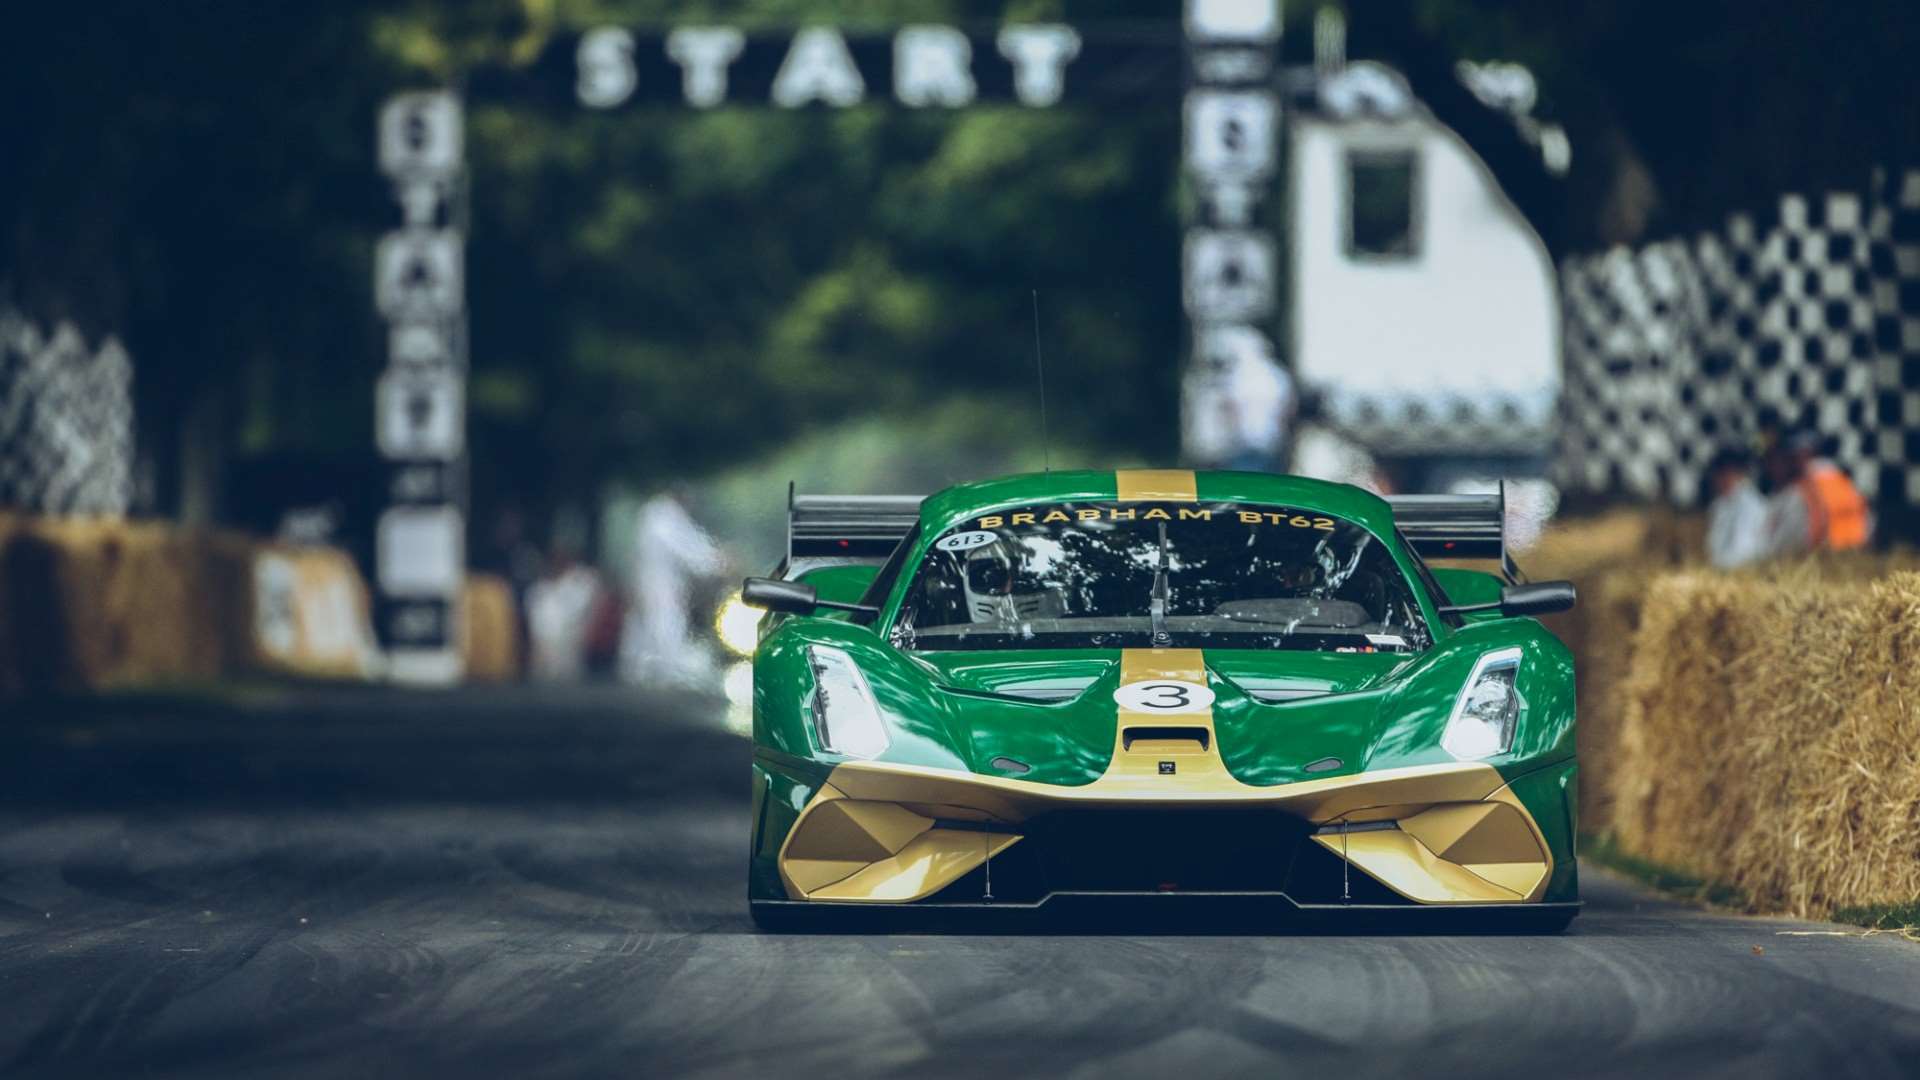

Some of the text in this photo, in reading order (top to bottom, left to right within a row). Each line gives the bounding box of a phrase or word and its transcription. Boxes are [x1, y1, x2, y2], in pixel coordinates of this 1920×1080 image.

[575, 25, 1083, 107] START
[977, 508, 1335, 531] BRABHAM BT62
[948, 534, 985, 547] 613
[1140, 684, 1190, 709] 3
